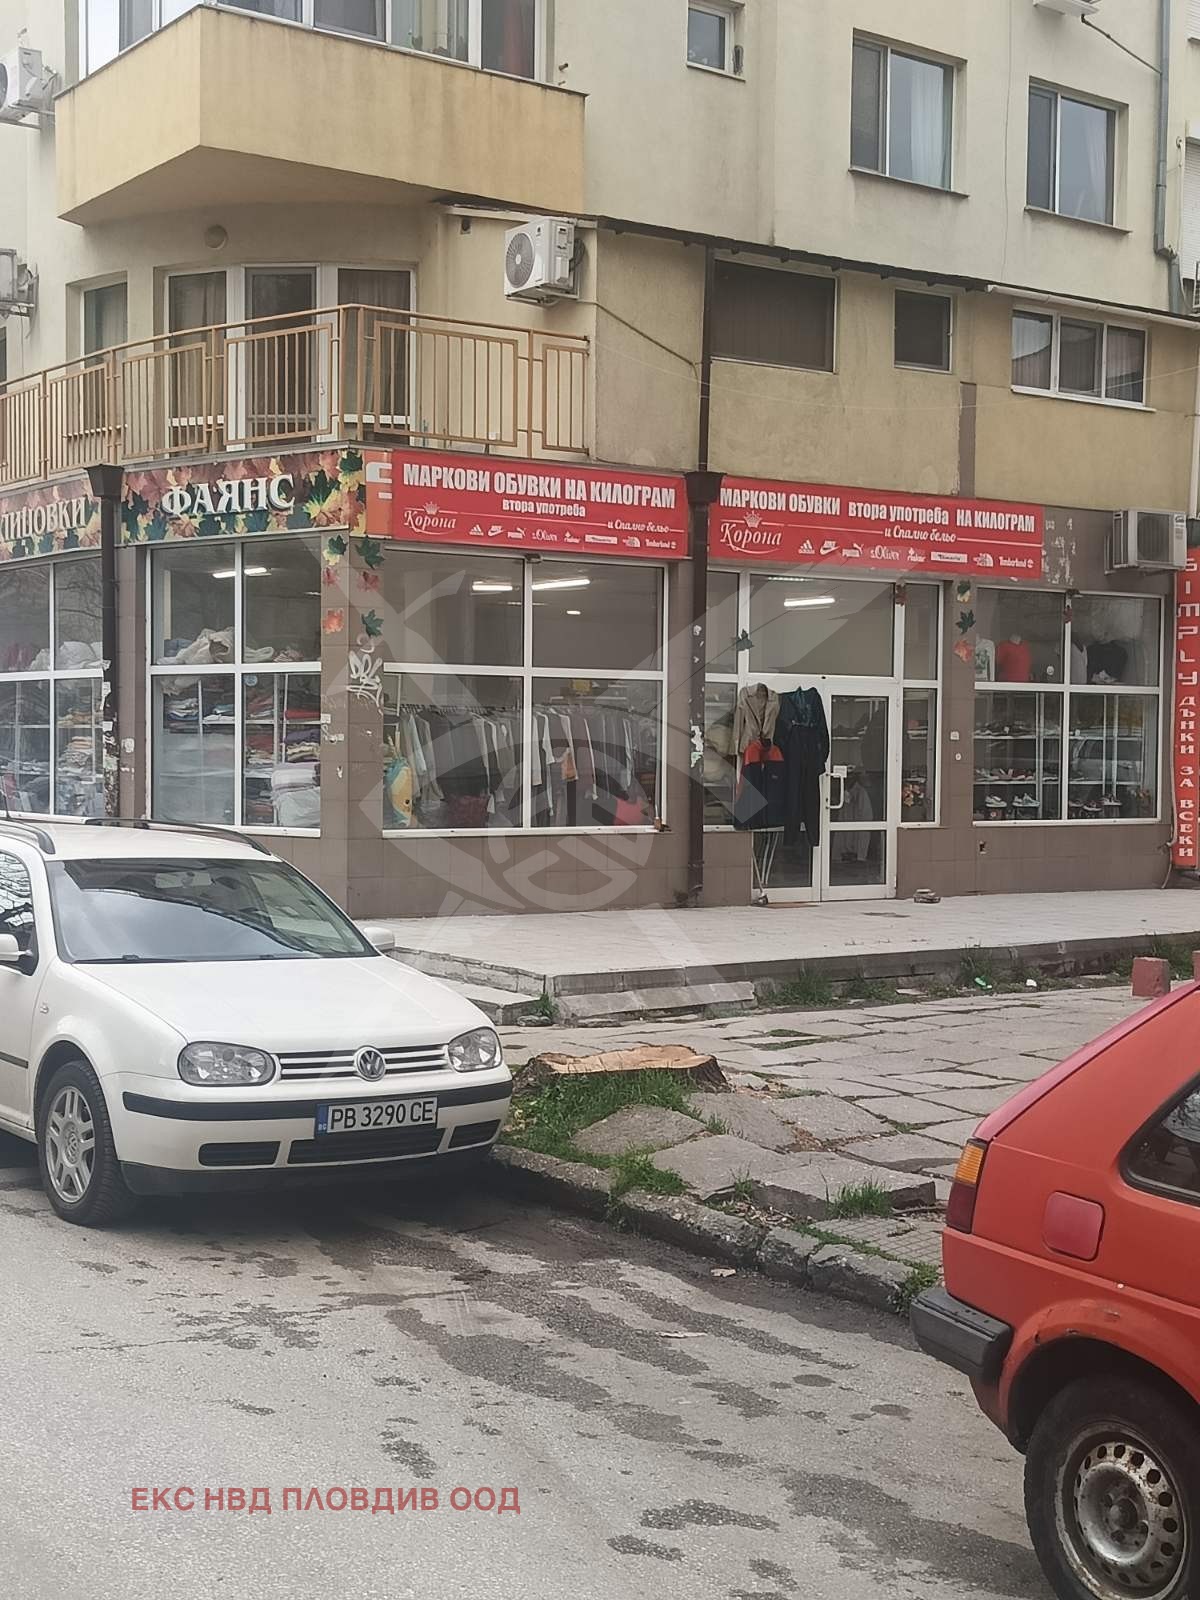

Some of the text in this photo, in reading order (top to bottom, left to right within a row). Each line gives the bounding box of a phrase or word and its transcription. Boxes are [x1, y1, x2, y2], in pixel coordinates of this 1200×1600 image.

[161, 474, 295, 518] ФАЯНС
[403, 463, 675, 509] МАРКОВИ ОБУВКИ НА КИЛОГРАМ
[403, 510, 457, 532] Корона
[502, 498, 586, 518] втора употреба
[720, 487, 1035, 533] МАРКОВИ ОБУВКИ втора употреба НА КИЛОГРАМ
[720, 522, 783, 551] Корона
[884, 525, 956, 543] и Спално бельо
[1178, 696, 1196, 857] ДЪНКИ ЗА ВСЕКИ
[330, 1107, 357, 1130] PB
[360, 1103, 406, 1127] 3290
[410, 1100, 434, 1122] CE
